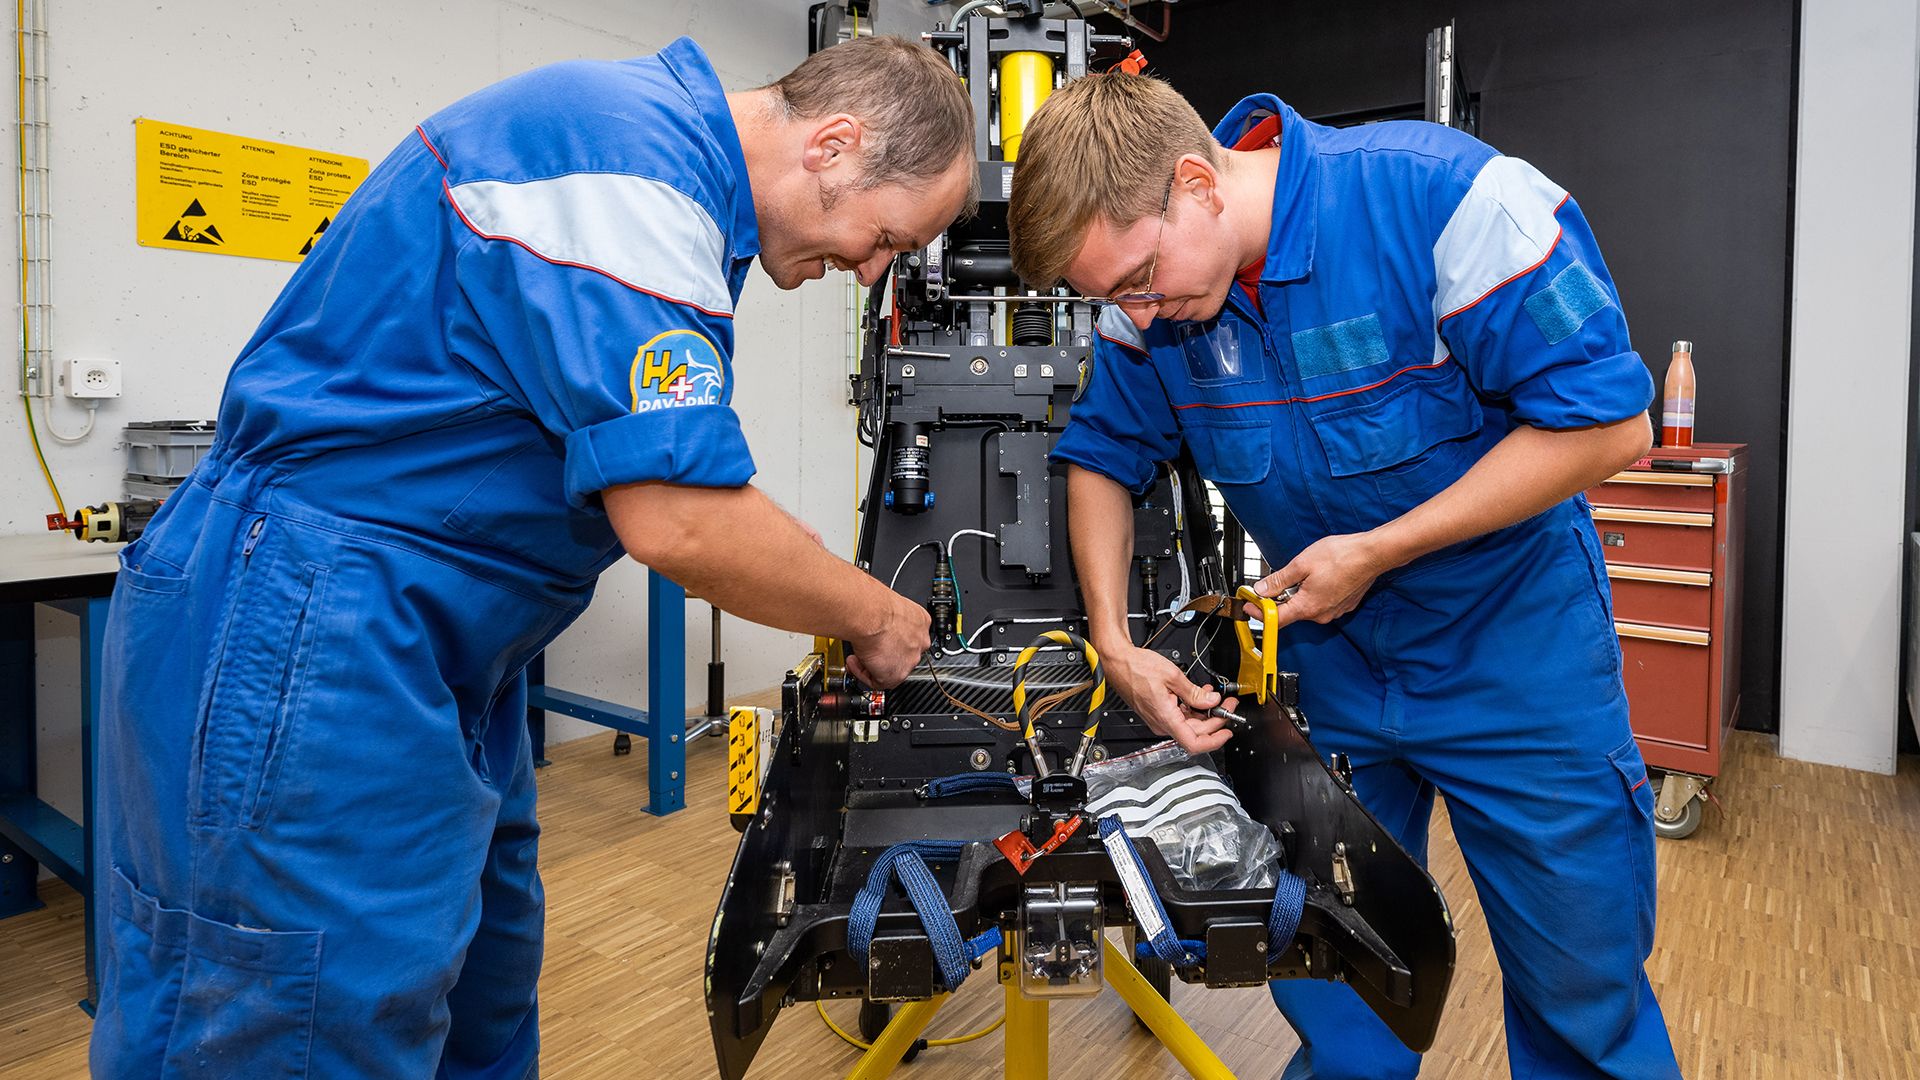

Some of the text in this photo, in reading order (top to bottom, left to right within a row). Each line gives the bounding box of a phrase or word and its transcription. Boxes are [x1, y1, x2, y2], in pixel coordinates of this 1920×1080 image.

[160, 130, 193, 140] ACHTUNG
[160, 142, 221, 158] ESD gesicherter
[160, 149, 190, 160] Bereich
[241, 144, 275, 155] ATTENTION
[309, 156, 343, 167] ATTENZIONE
[241, 172, 259, 180] Zone
[309, 168, 326, 176] Zona
[241, 179, 257, 187] ESD
[309, 174, 323, 182] ESD
